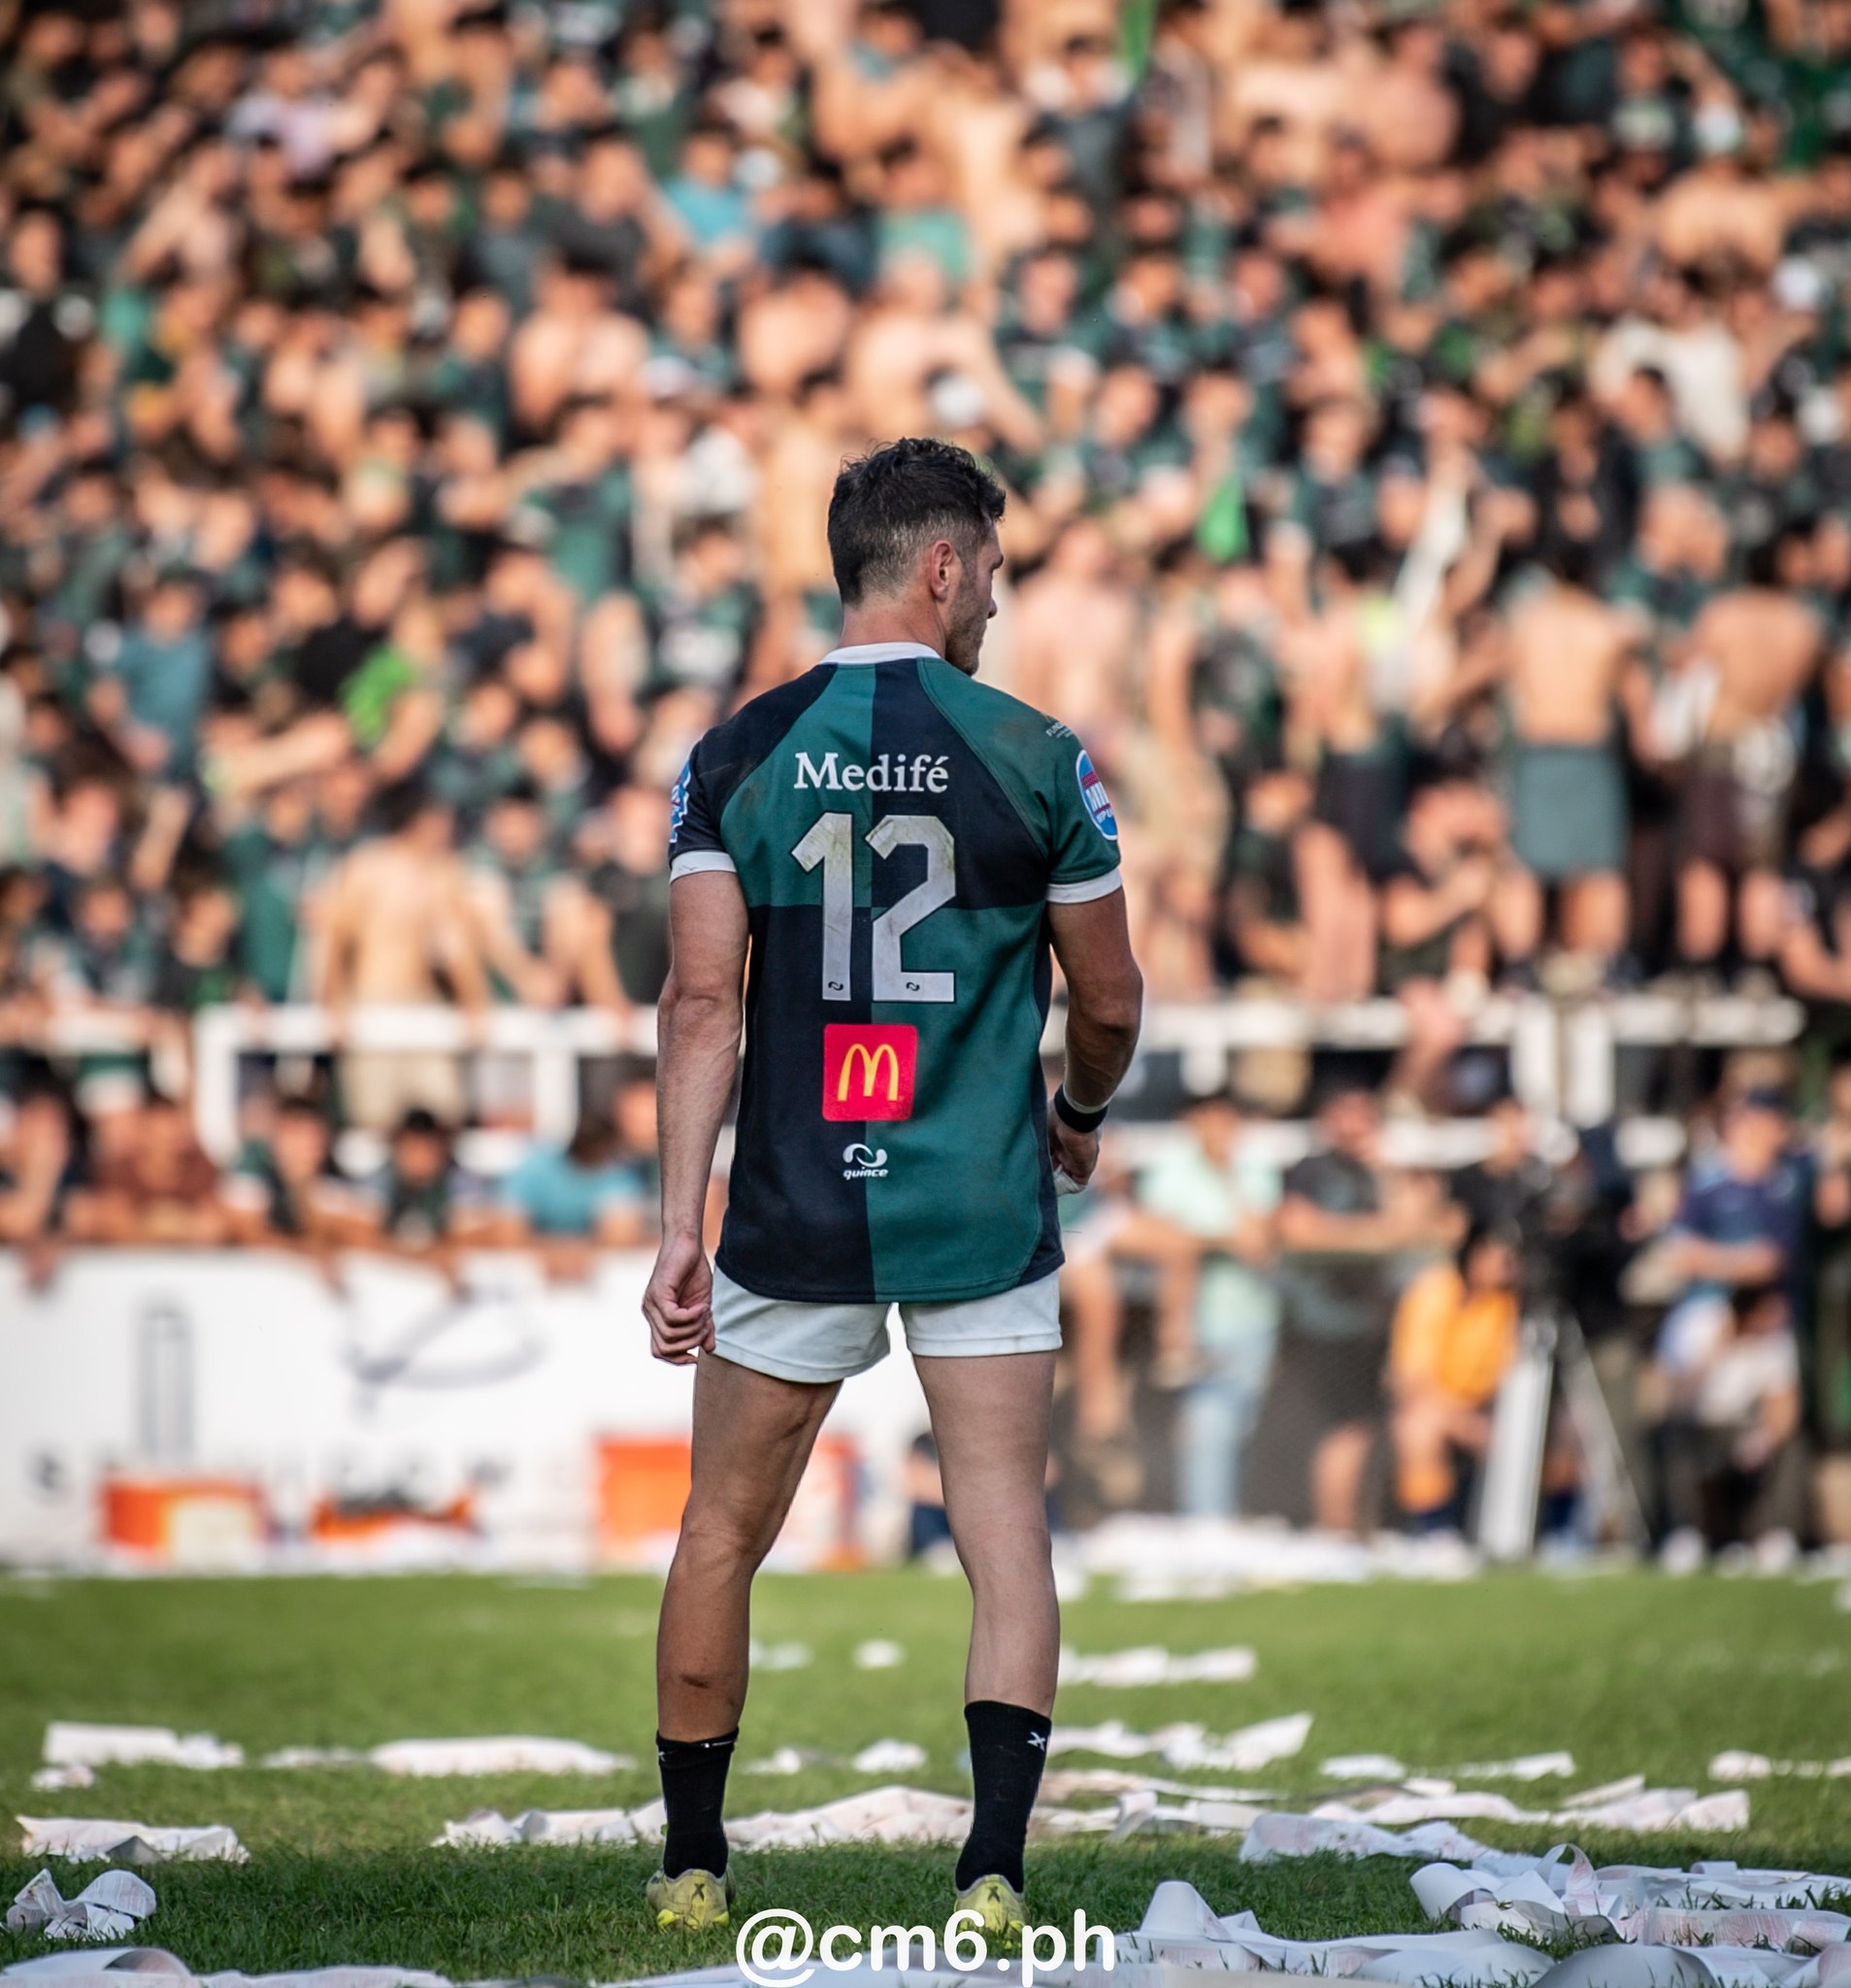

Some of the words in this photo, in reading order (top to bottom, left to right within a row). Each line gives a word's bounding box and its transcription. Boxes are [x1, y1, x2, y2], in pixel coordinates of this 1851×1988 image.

[793, 752, 949, 794] Medifé
[791, 812, 956, 1002] 12
[843, 1166, 889, 1180] quince
